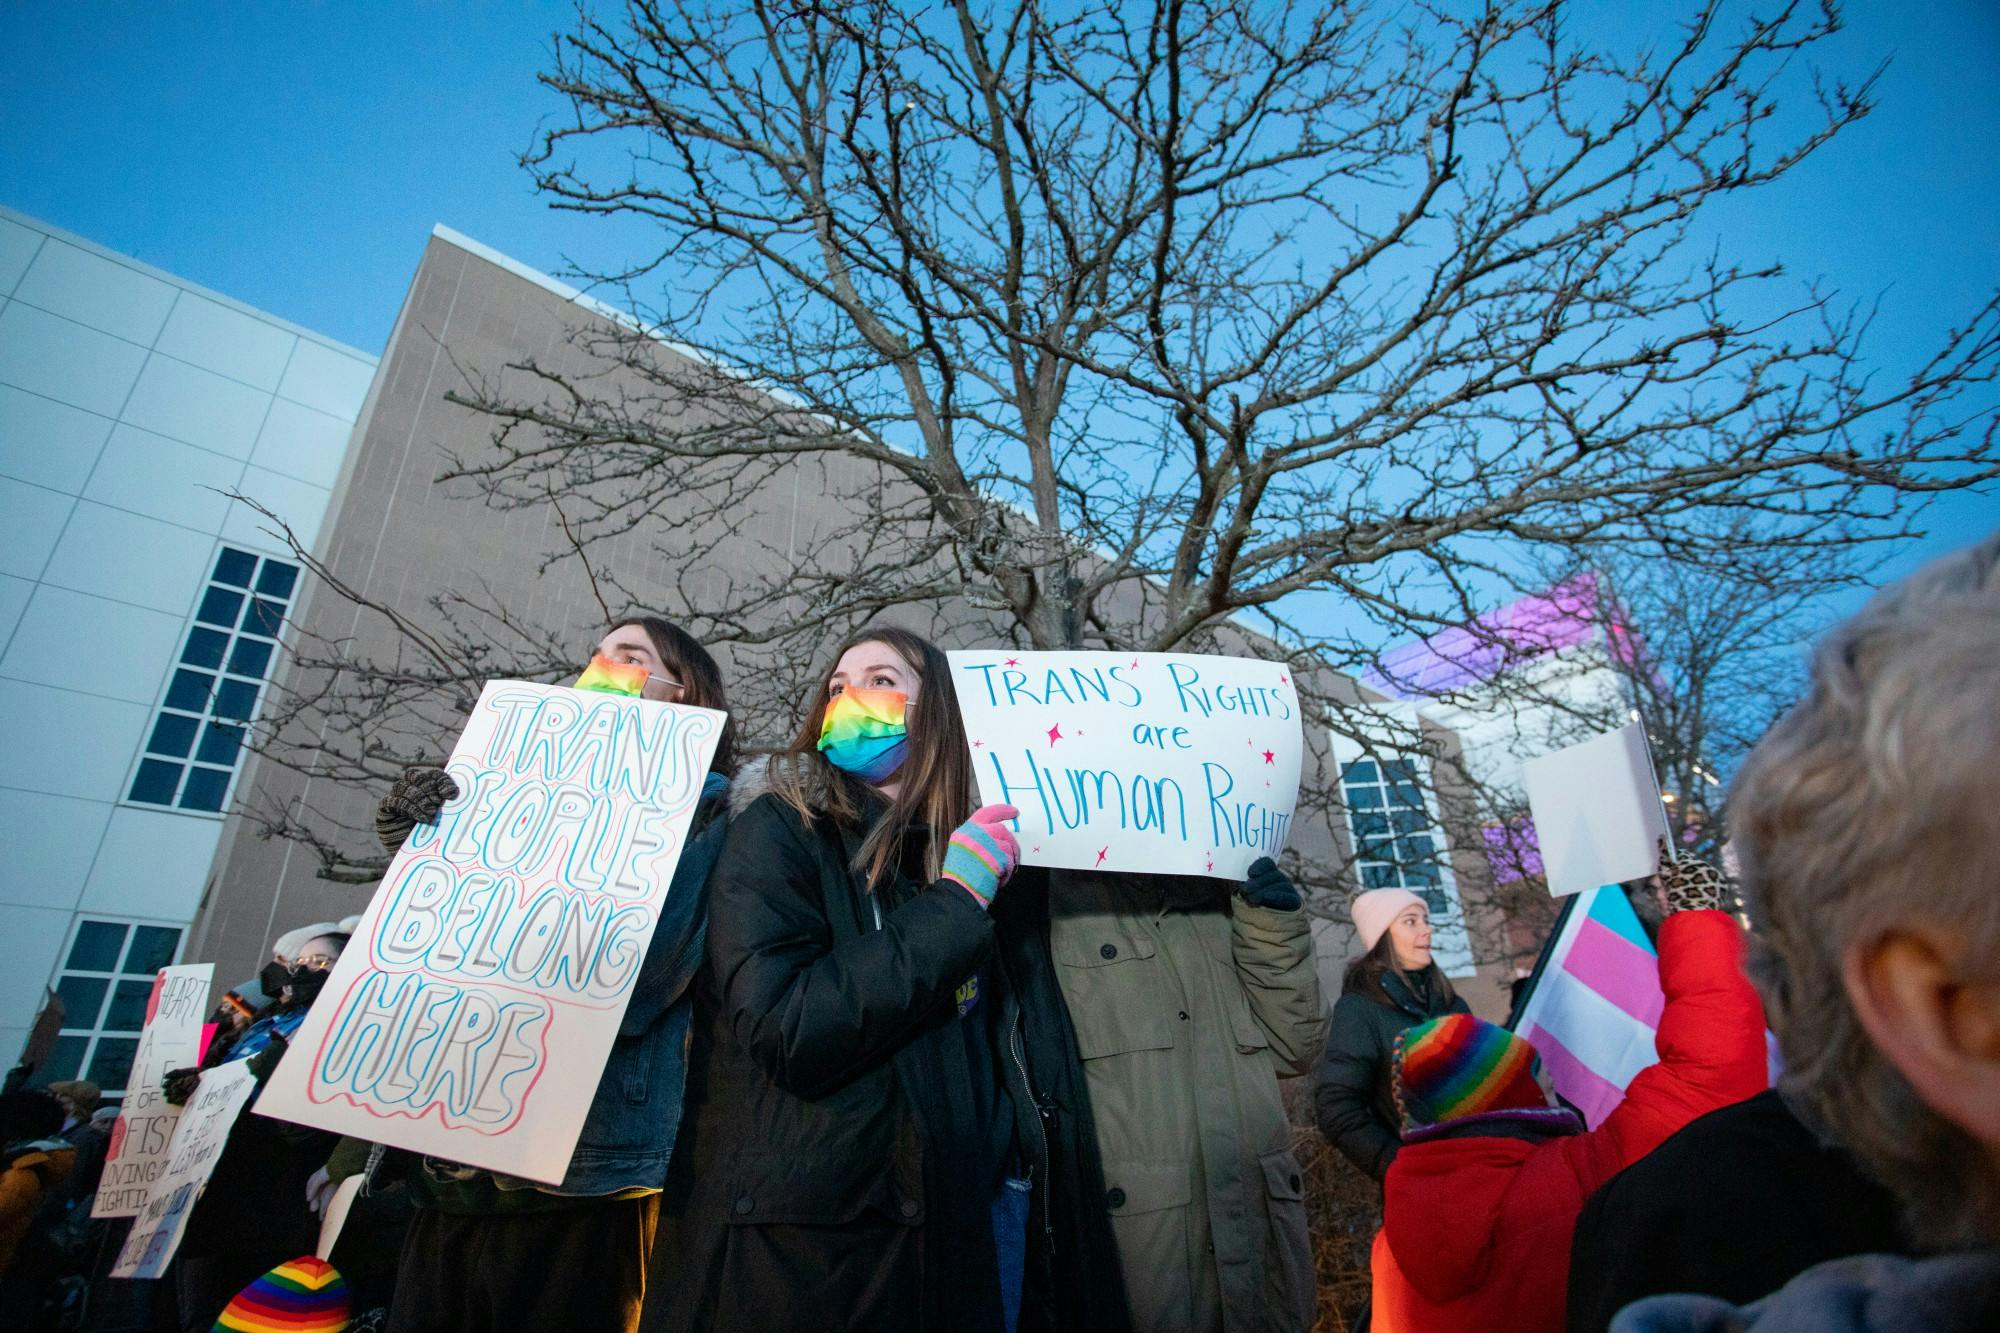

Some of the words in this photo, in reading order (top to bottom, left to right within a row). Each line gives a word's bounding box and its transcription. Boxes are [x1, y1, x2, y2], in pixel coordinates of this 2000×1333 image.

[963, 663, 1143, 708] TRANS
[1166, 662, 1291, 721] RIGHTS
[487, 694, 714, 805] TRANS
[1132, 722, 1193, 750] are
[377, 856, 651, 1000] BELONG
[160, 975, 211, 1027] HEART
[321, 970, 547, 1124] HERE
